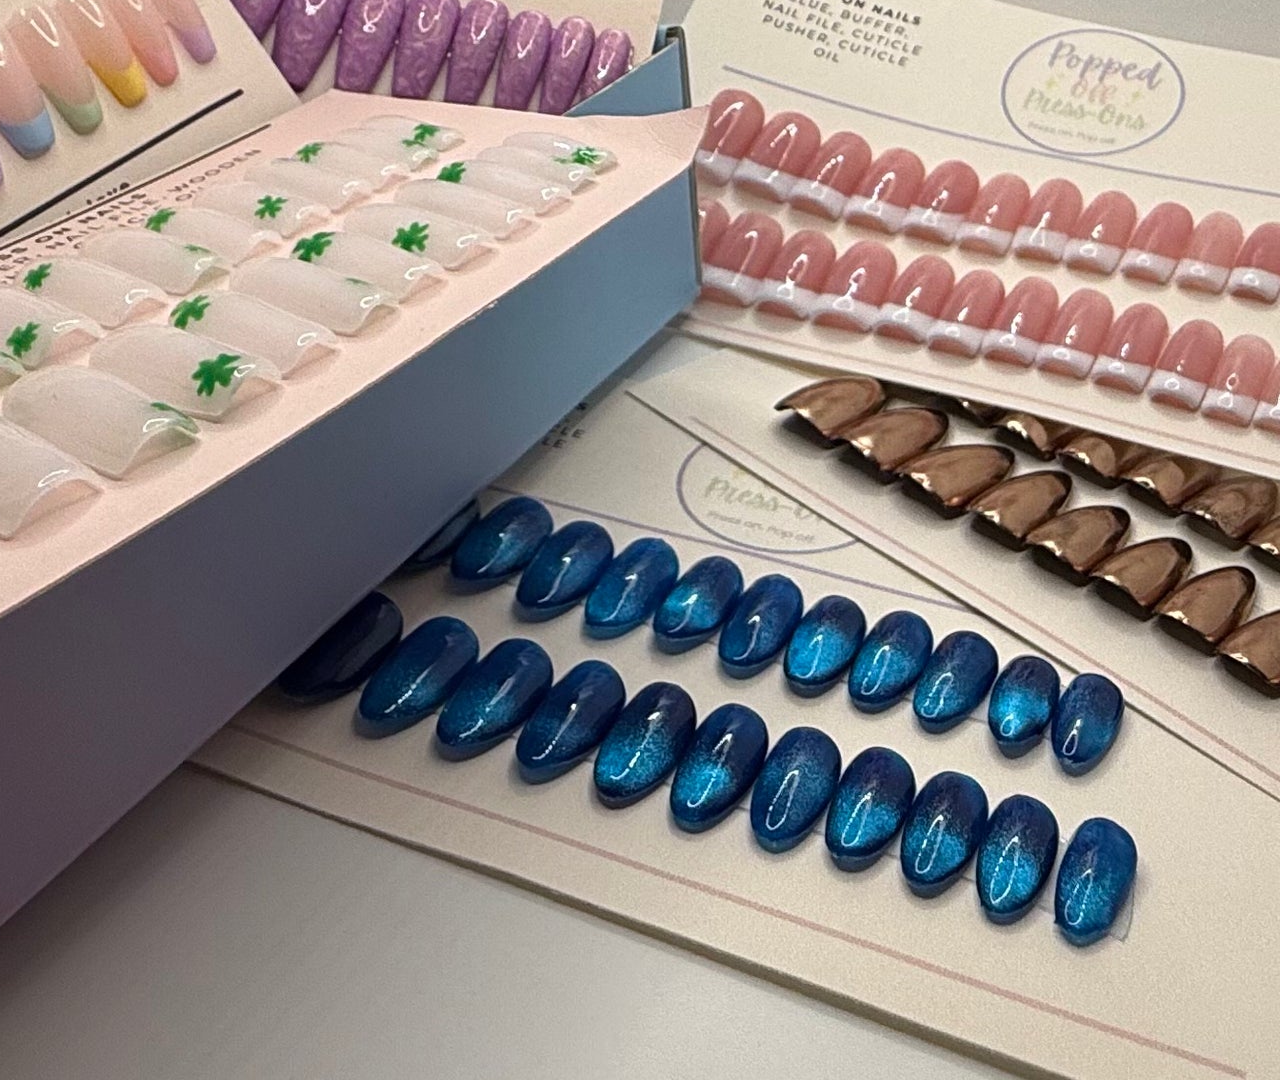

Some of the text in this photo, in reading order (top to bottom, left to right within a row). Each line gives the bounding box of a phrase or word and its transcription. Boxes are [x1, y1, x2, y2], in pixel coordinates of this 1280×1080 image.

[763, 0, 923, 56] NAIL FILE, CUTICLE
[840, 9, 908, 38] BUFFER,
[872, 4, 922, 26] NAILS
[762, 14, 909, 67] PUSHER, CUTICLE
[813, 47, 840, 63] OIL
[1048, 39, 1163, 90] Popped
[1024, 87, 1147, 131] Press-Ons
[1070, 77, 1117, 105] Off
[34, 226, 72, 244] ON
[78, 193, 147, 224] NAILS
[45, 224, 104, 250] NAIL
[166, 148, 262, 192] WOODEN
